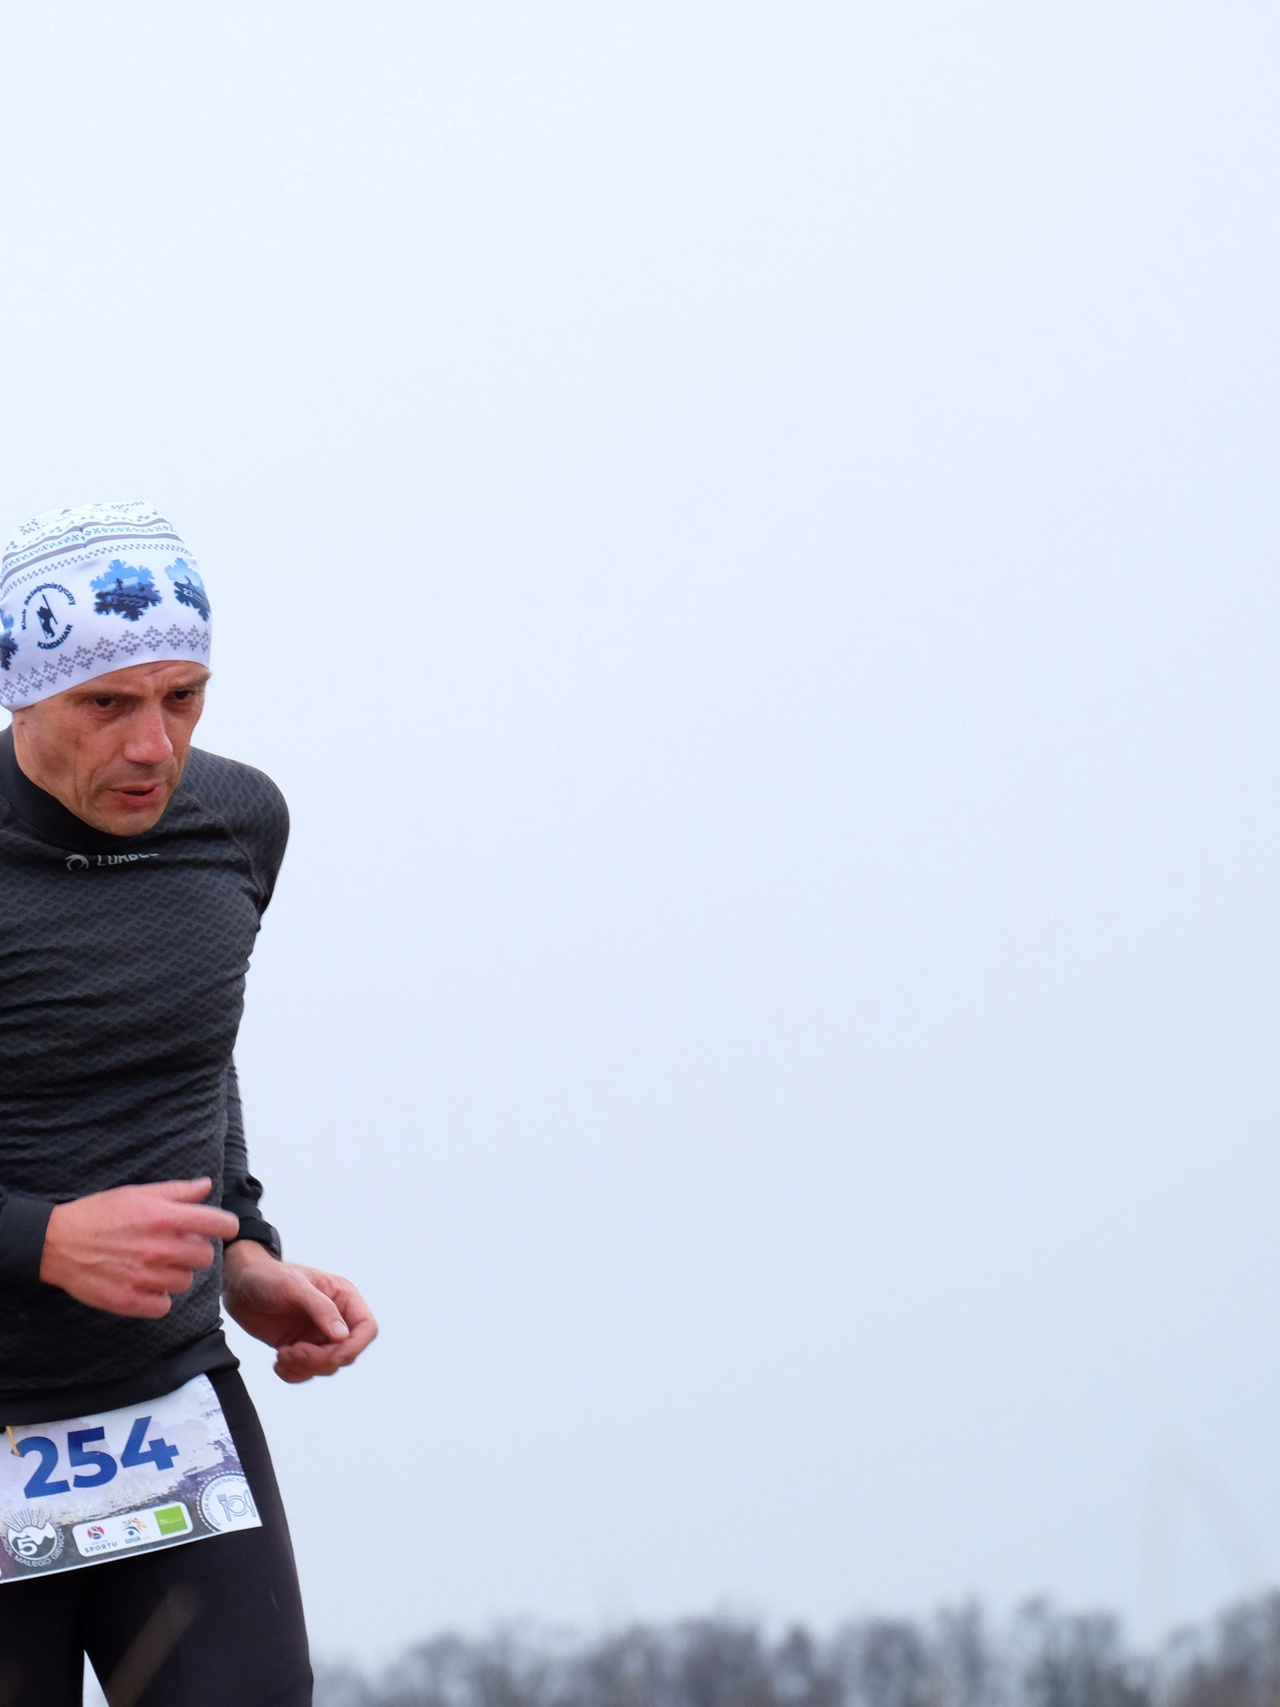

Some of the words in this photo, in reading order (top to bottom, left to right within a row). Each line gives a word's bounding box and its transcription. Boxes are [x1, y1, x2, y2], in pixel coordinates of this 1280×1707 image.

[37, 624, 73, 650] KANDAHAR
[11, 1415, 180, 1499] 254
[16, 1538, 38, 1556] 5
[84, 1541, 118, 1553] SPORTU
